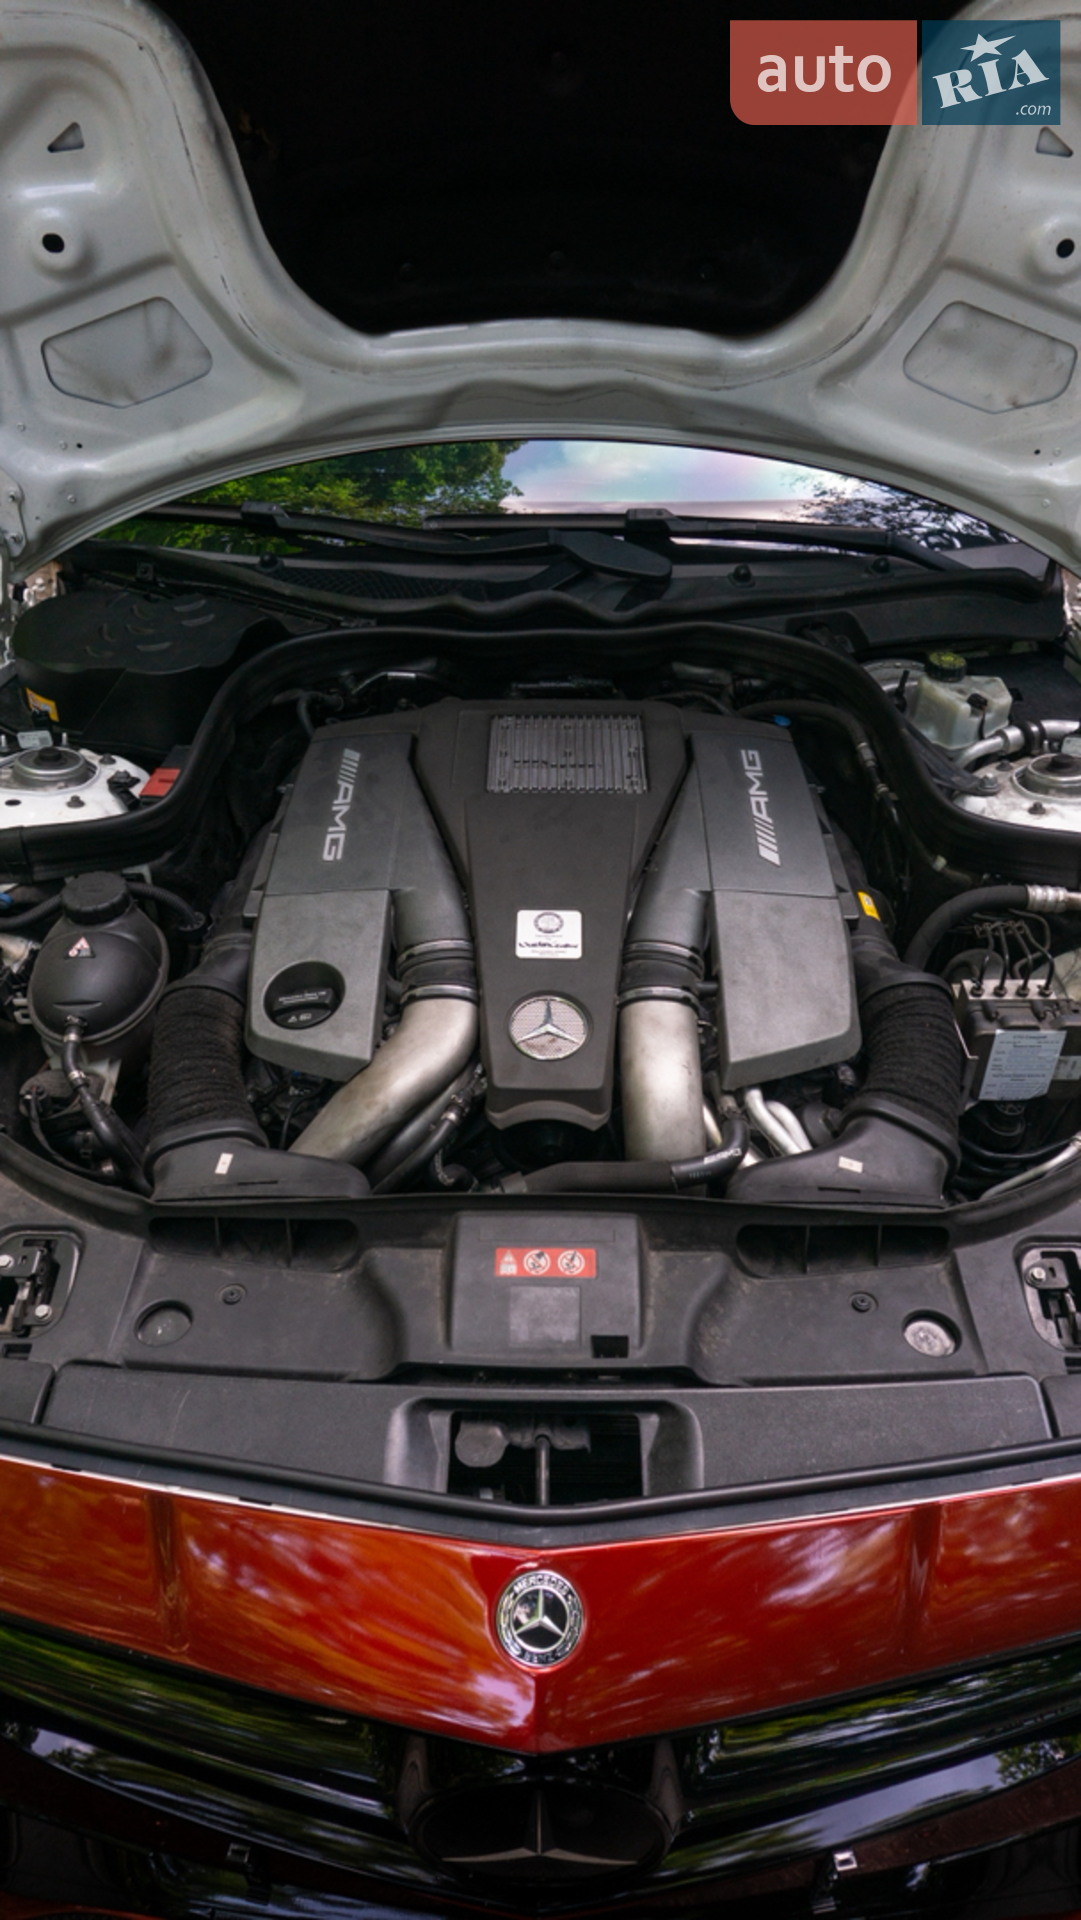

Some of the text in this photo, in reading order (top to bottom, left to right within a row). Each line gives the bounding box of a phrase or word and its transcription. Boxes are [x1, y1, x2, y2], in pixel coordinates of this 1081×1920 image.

[323, 779, 354, 861] AMG
[741, 749, 773, 824] AMG
[513, 1574, 569, 1594] MERCEDES
